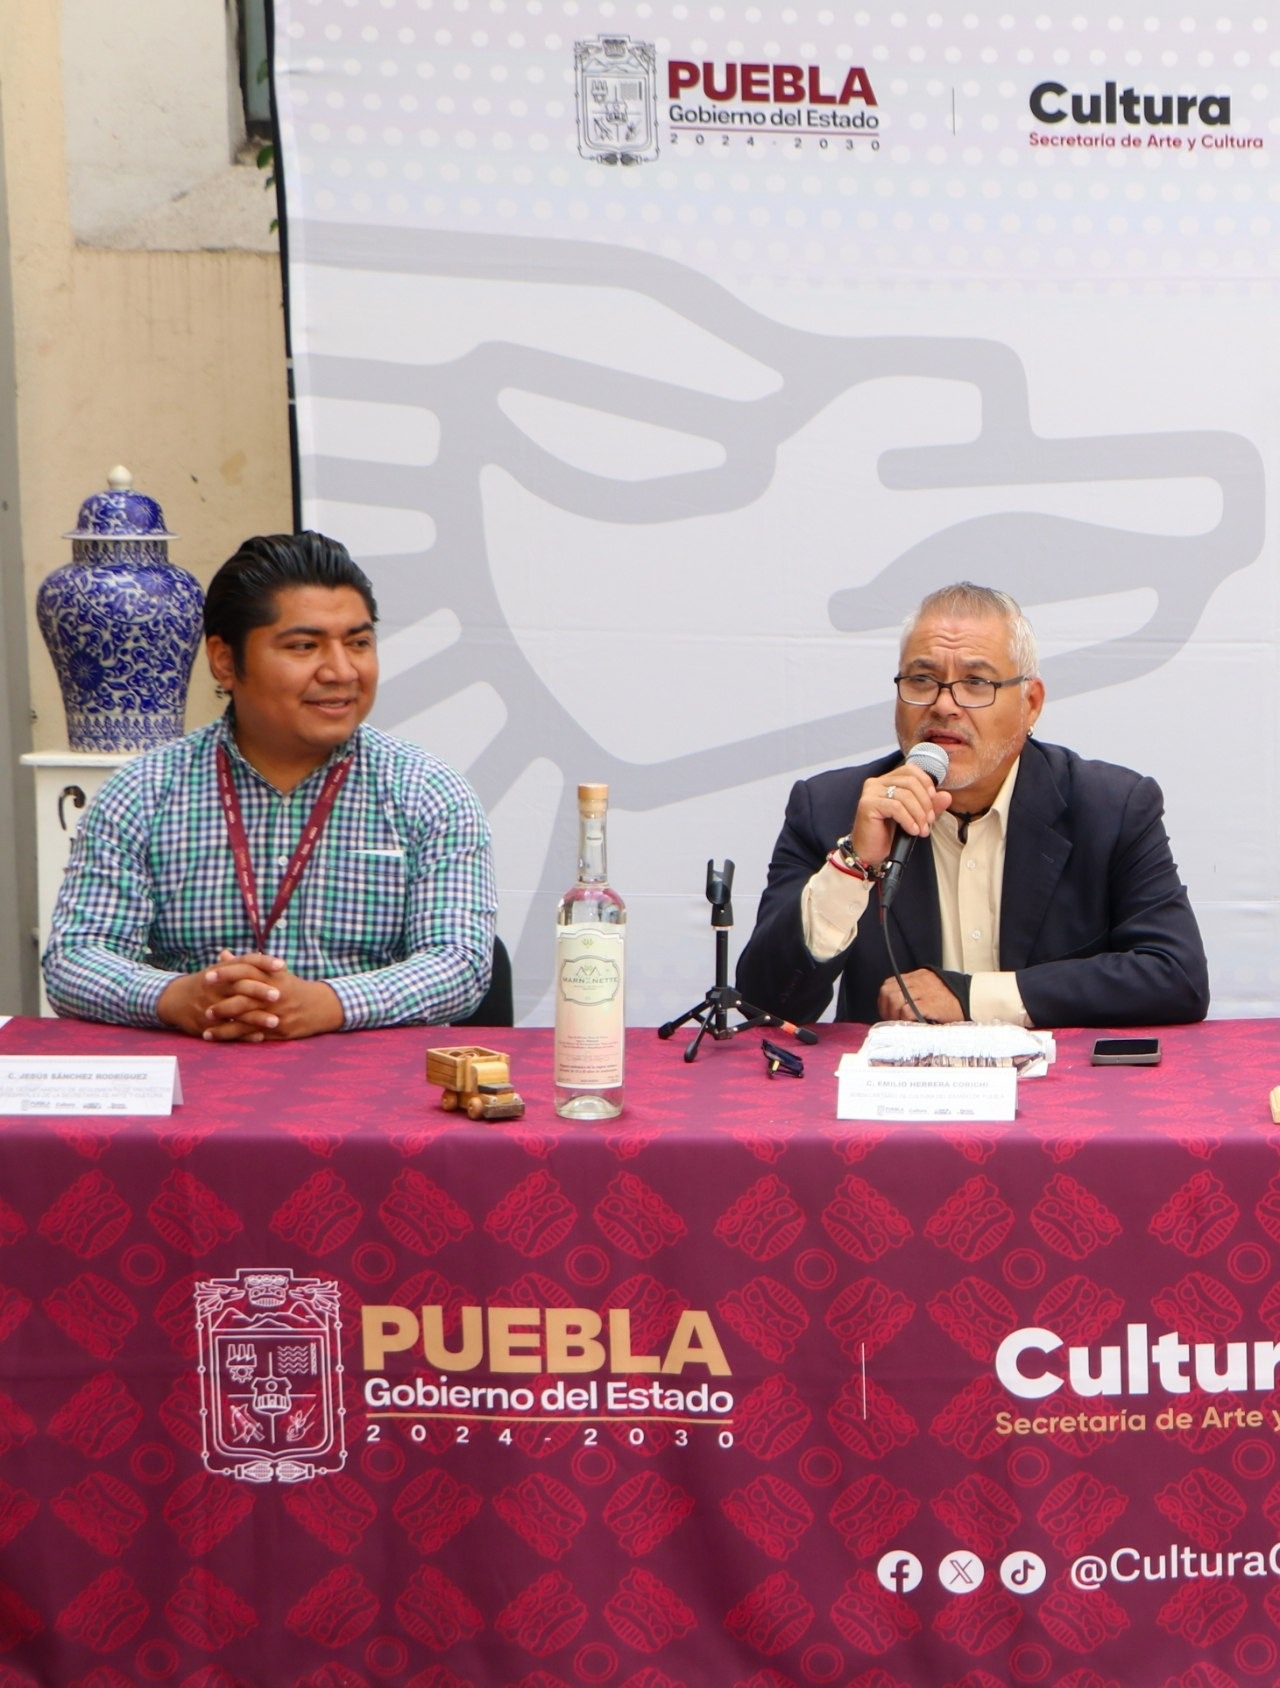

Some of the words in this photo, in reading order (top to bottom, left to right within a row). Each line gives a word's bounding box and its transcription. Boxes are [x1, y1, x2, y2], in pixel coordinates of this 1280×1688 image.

[668, 60, 879, 106] PUEBLA
[669, 104, 768, 128] Gobierno
[770, 107, 803, 128] del
[806, 108, 880, 130] Estado
[1029, 80, 1232, 126] Cultura
[1029, 131, 1117, 149] Secretaría
[1120, 133, 1142, 149] de
[1146, 133, 1183, 149] Arte
[1187, 137, 1196, 152] y
[1201, 133, 1265, 149] Cultura
[8, 1072, 17, 1080] C.
[877, 1080, 908, 1088] EMILIO
[360, 1304, 733, 1376] PUEBLA
[364, 1377, 537, 1410] Gobierno
[541, 1380, 598, 1411] del
[606, 1382, 734, 1414] Estado
[995, 1408, 1147, 1436] Secretaría
[1155, 1407, 1193, 1432] de
[1201, 1404, 1264, 1430] Arte
